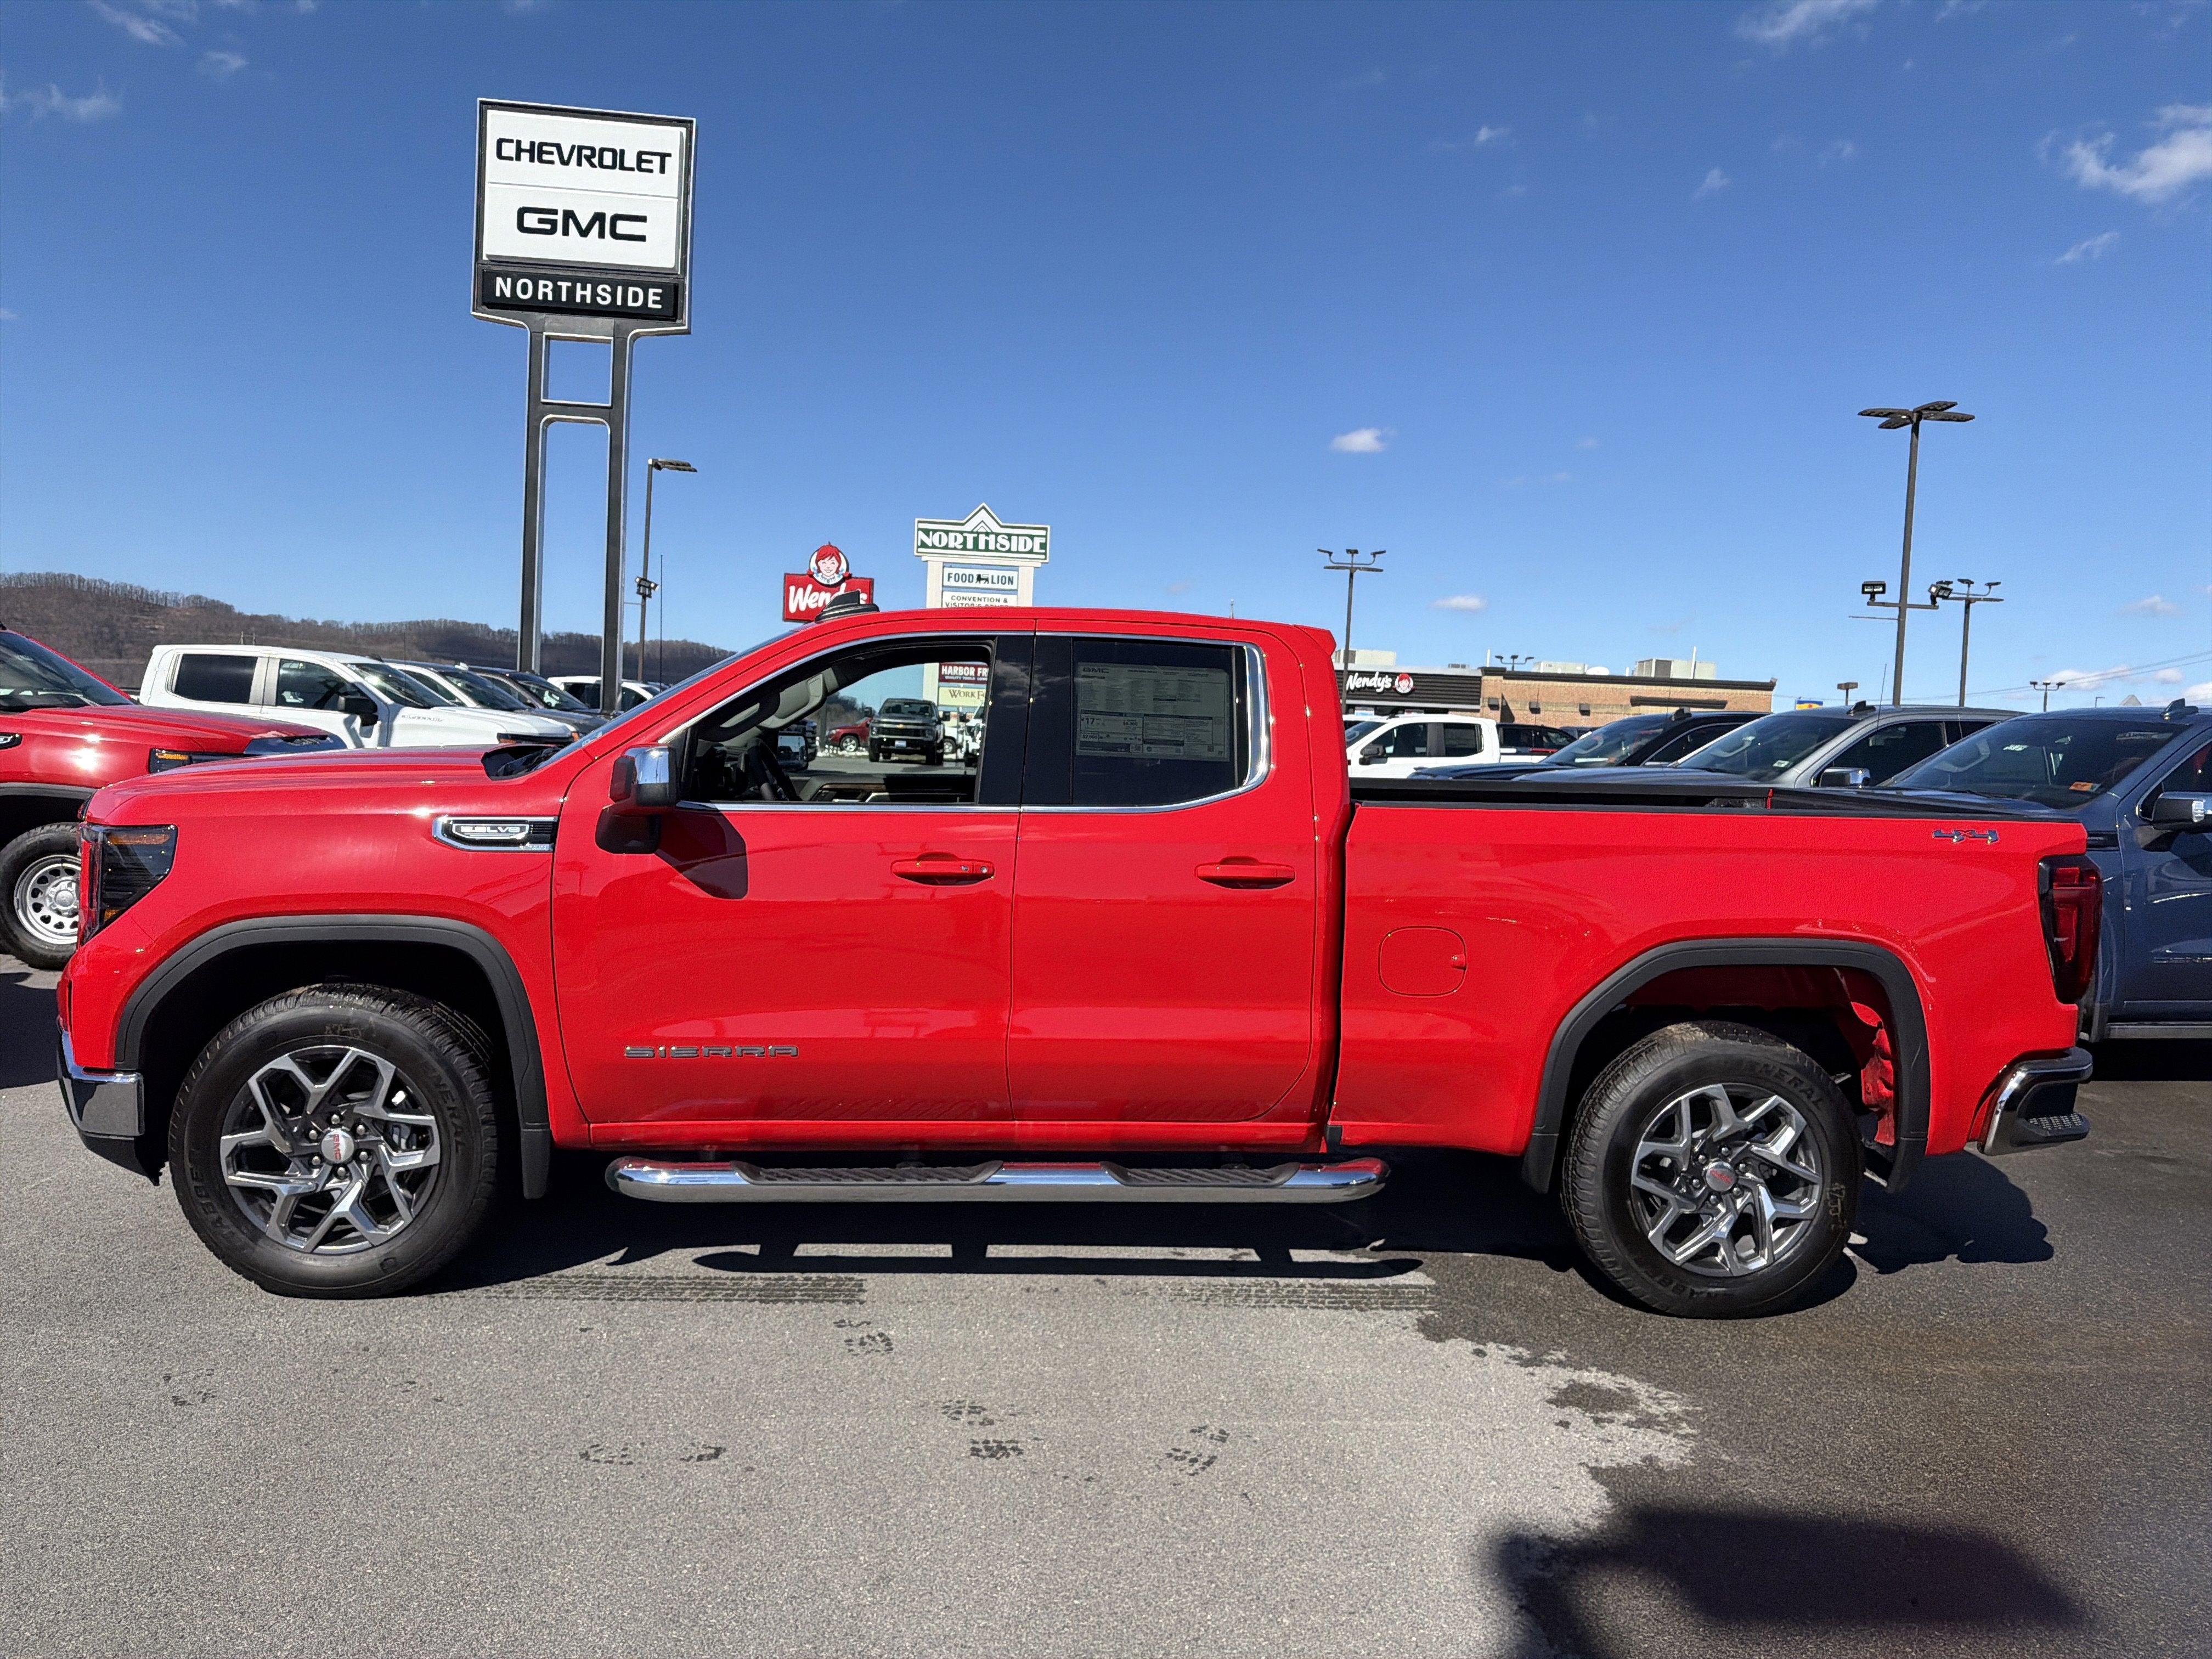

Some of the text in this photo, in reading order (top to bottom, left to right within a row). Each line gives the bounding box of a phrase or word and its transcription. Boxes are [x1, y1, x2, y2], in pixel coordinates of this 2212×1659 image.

[496, 137, 672, 174] CHEVROLET
[516, 206, 647, 242] GMC
[495, 276, 662, 309] NORTHSIDE
[918, 530, 1046, 553] NORTHSIDE
[947, 572, 1014, 585] FOOD LION
[789, 583, 867, 613] Wen's
[941, 665, 975, 676] HARBOR
[949, 689, 976, 698] WORK
[624, 1046, 798, 1058] SIERRA
[333, 1133, 342, 1161] GMC
